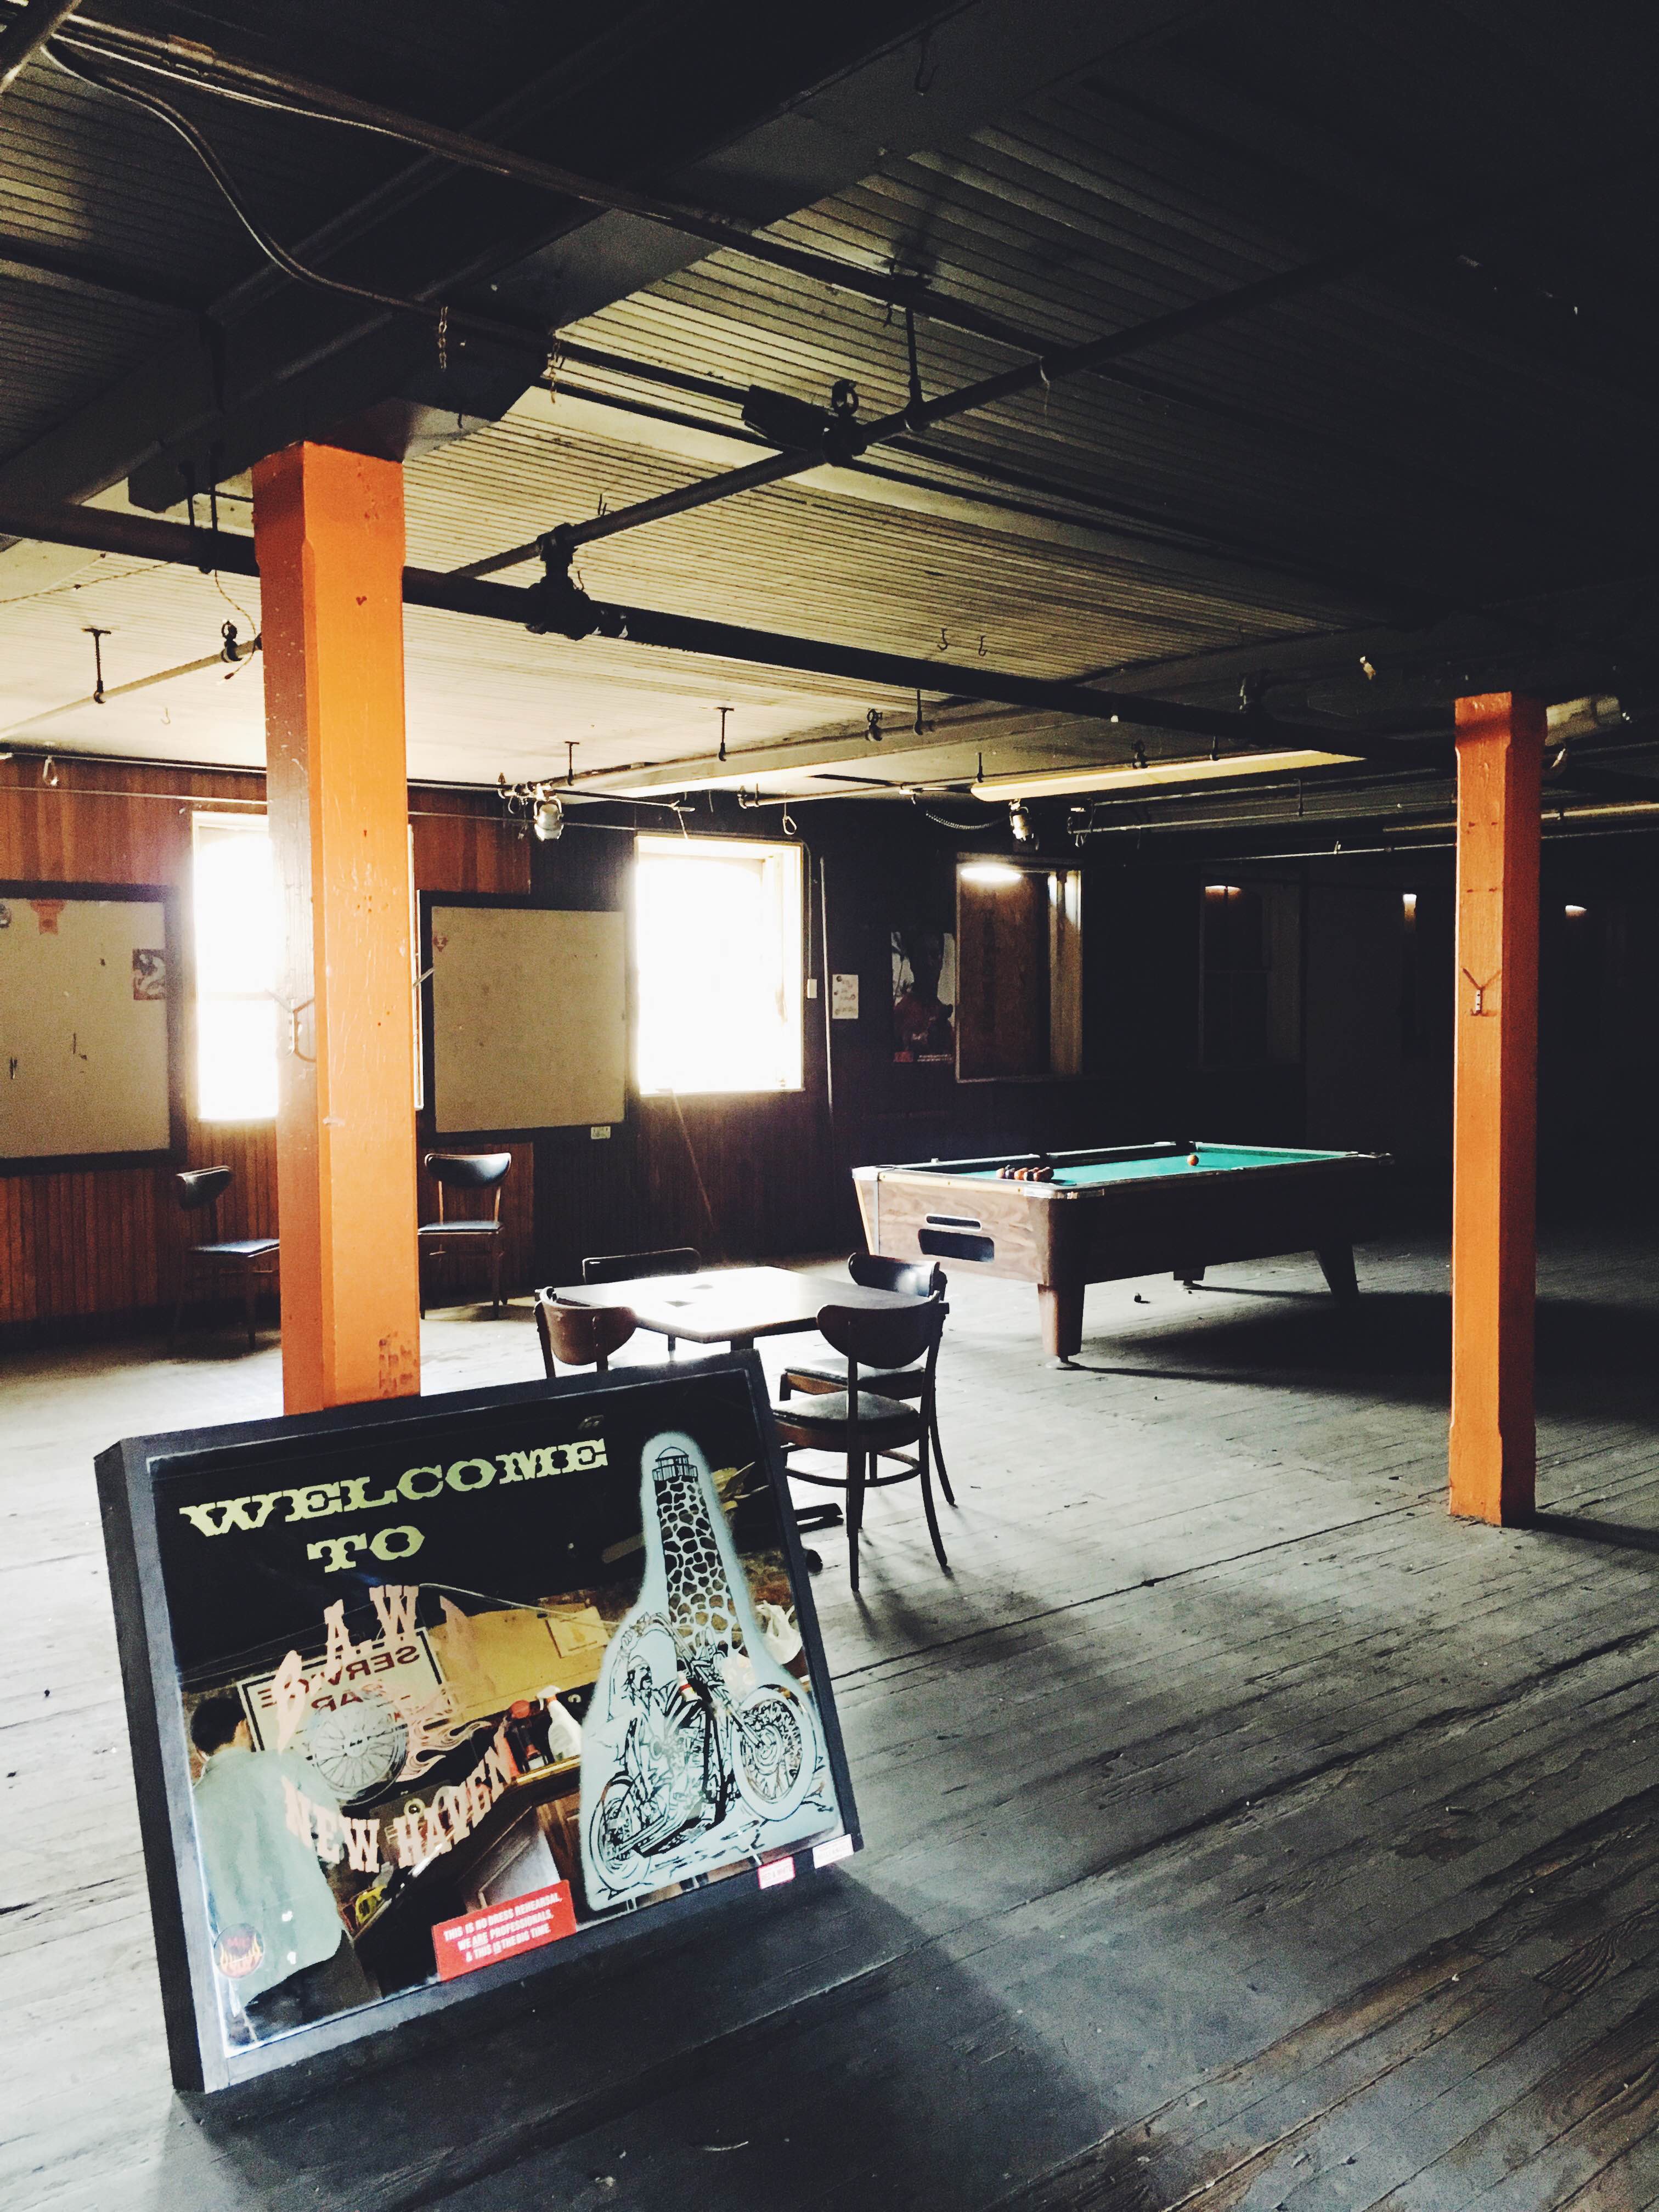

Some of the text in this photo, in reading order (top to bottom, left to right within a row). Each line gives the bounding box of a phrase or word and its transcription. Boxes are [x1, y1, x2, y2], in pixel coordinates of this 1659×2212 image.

[179, 1438, 608, 1537] WELCOME
[307, 1526, 425, 1573] TO
[281, 1720, 511, 1873] NEW HAVEN
[443, 1926, 463, 1942] THIS
[465, 1922, 475, 1934] IS
[475, 1917, 488, 1931] NO
[487, 1908, 514, 1926] DRESS
[457, 1938, 472, 1951] WE
[472, 1932, 488, 1949] ARE
[466, 1951, 473, 1962] &
[473, 1944, 492, 1960] THIS
[493, 1940, 502, 1954] IS
[500, 1934, 517, 1950] THE
